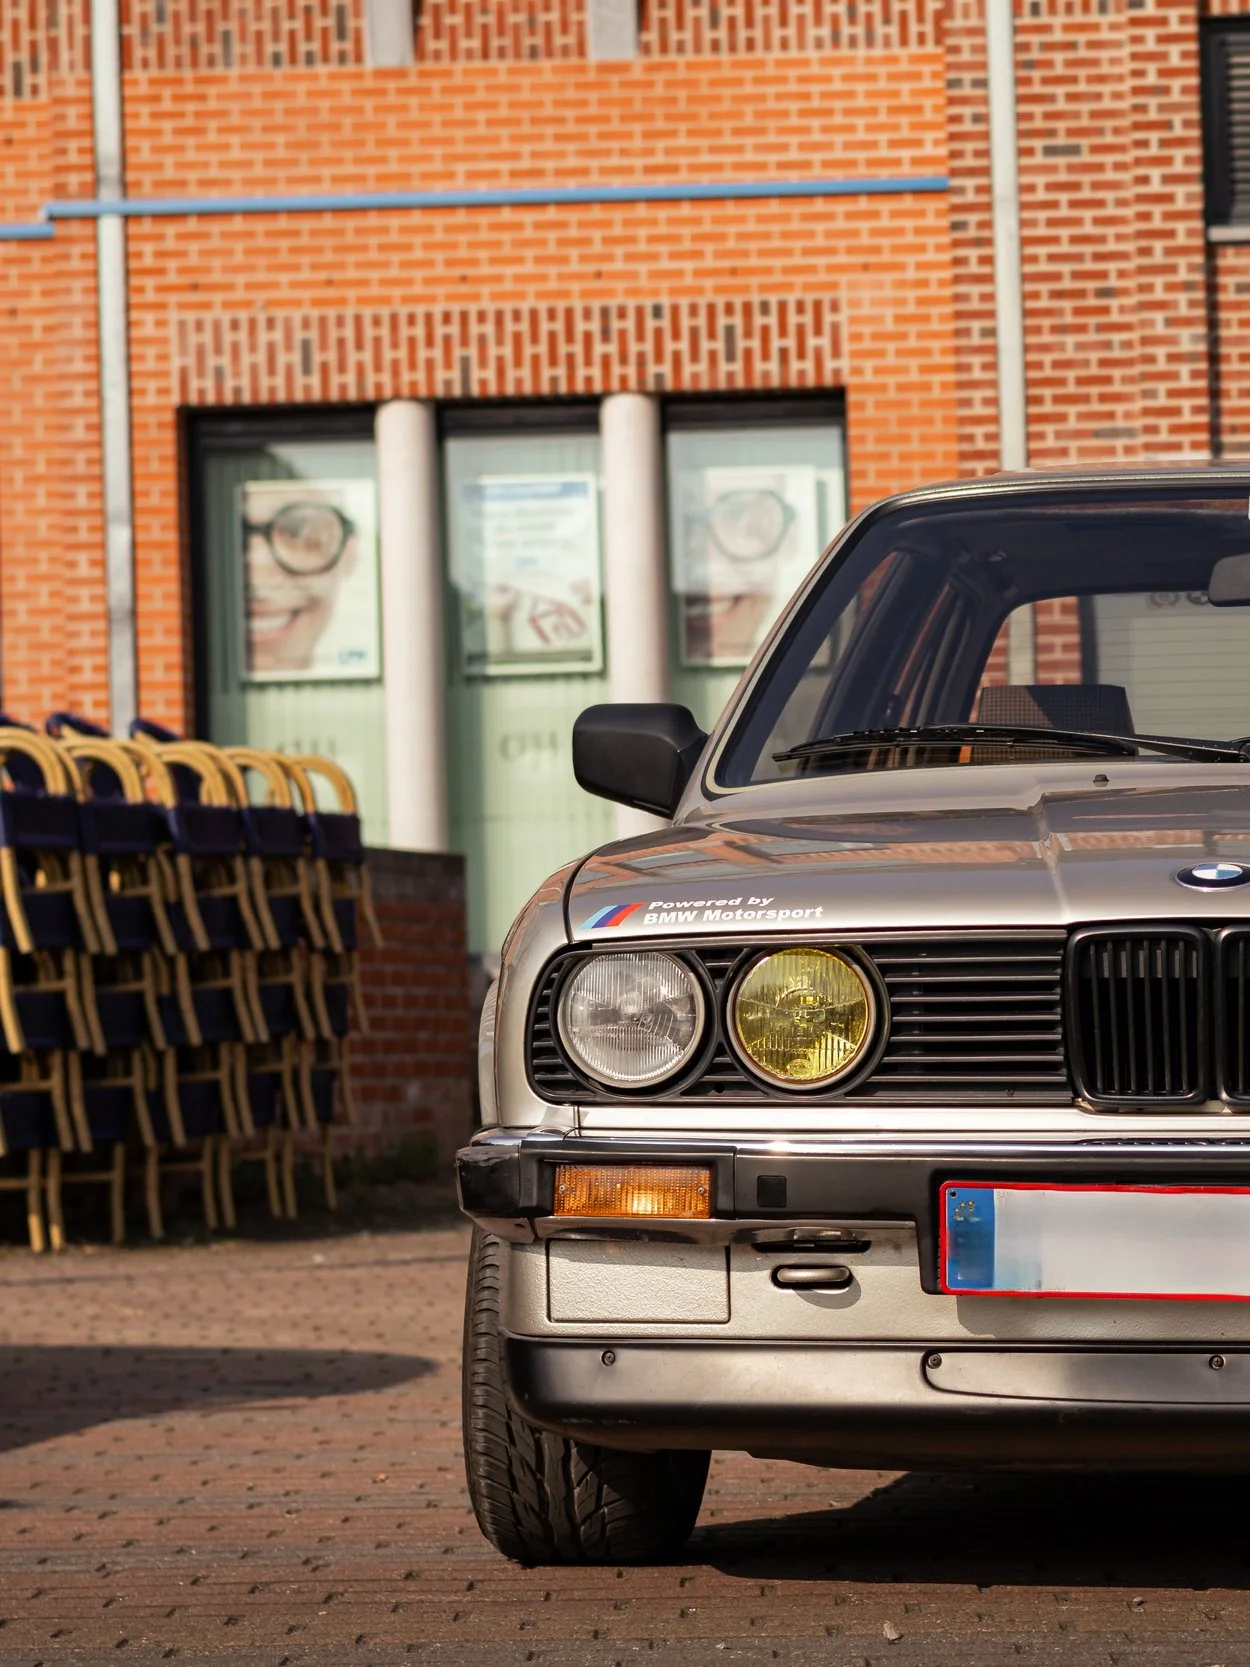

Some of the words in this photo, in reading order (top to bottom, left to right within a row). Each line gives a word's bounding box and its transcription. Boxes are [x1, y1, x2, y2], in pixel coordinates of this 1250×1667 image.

[648, 897, 743, 909] Powered
[747, 896, 775, 906] by
[643, 911, 697, 925] BMW
[702, 906, 823, 921] Motorsport
